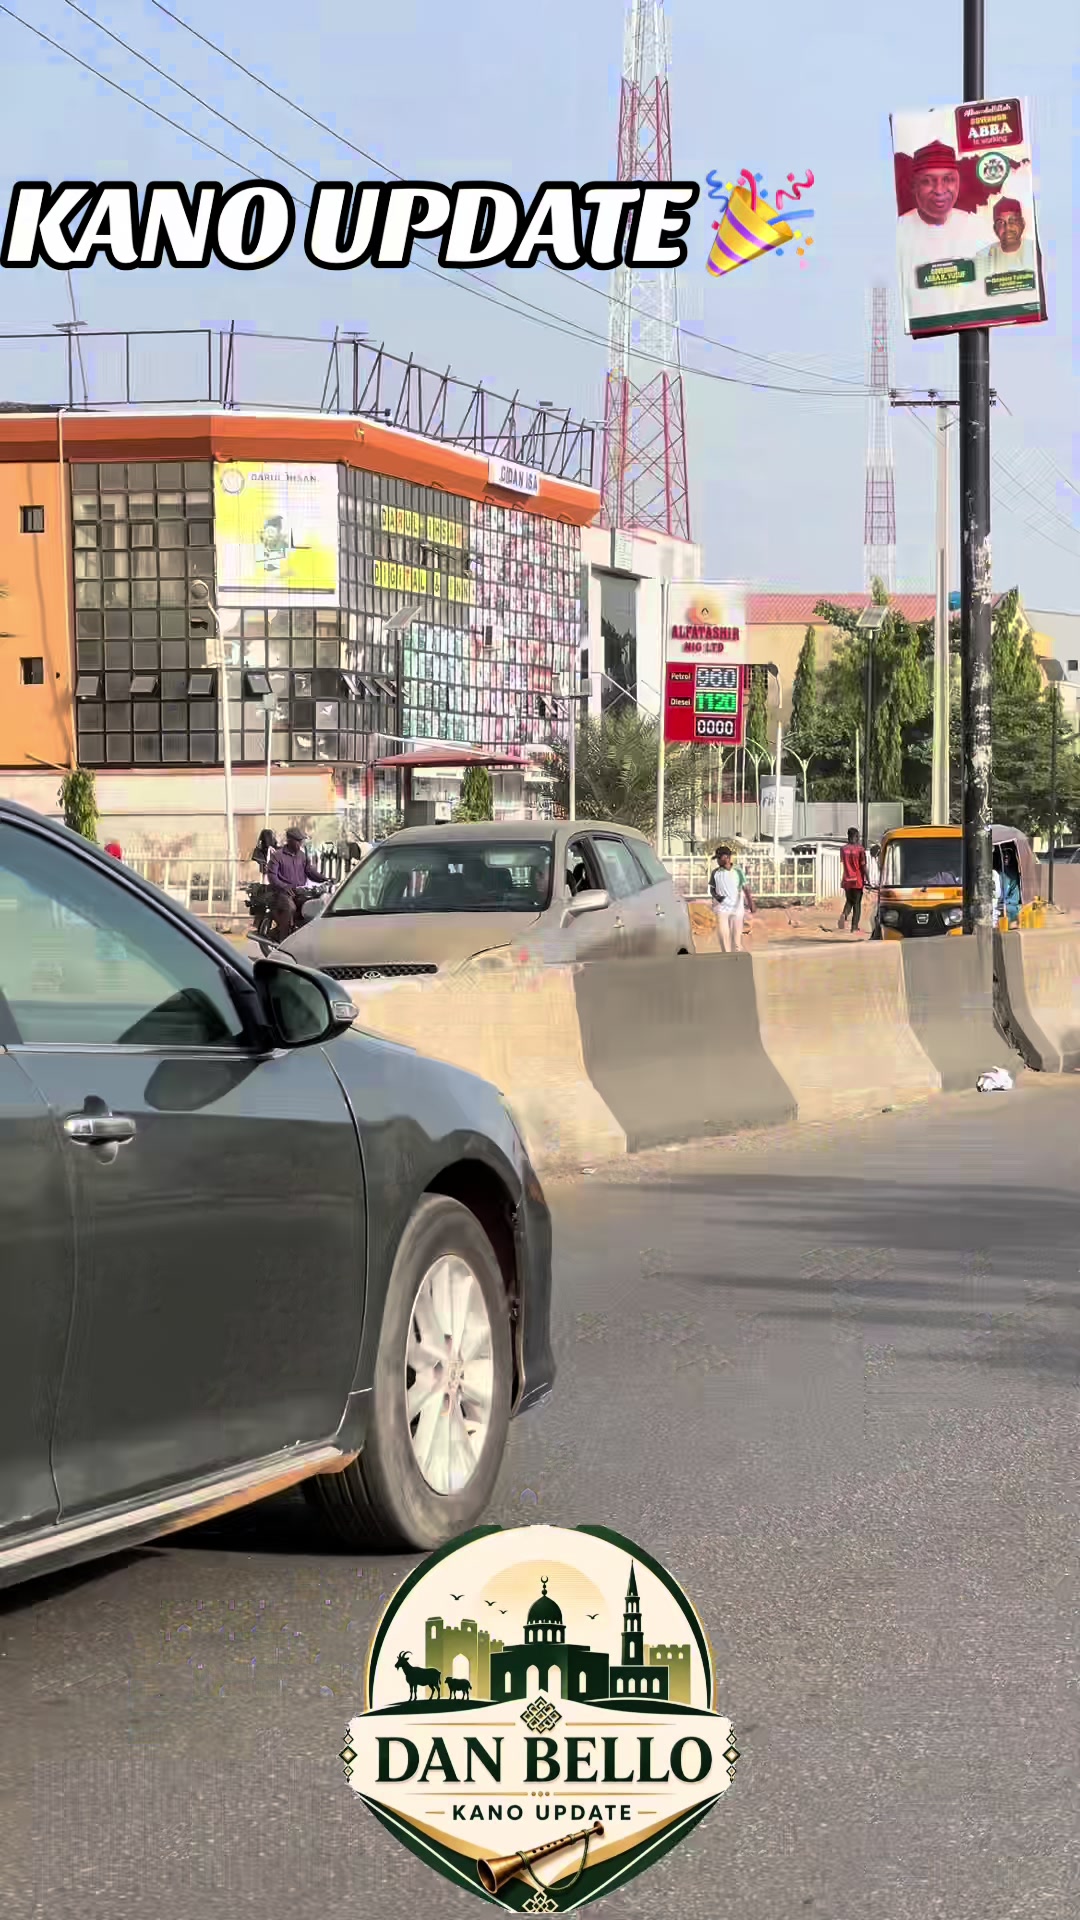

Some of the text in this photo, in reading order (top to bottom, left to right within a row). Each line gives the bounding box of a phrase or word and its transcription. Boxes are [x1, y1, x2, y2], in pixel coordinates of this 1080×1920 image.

[967, 122, 1013, 139] ABBA
[525, 471, 538, 489] ISA
[704, 642, 724, 653] LTD
[670, 693, 736, 711] Diesel 1120
[697, 719, 734, 735] 0000
